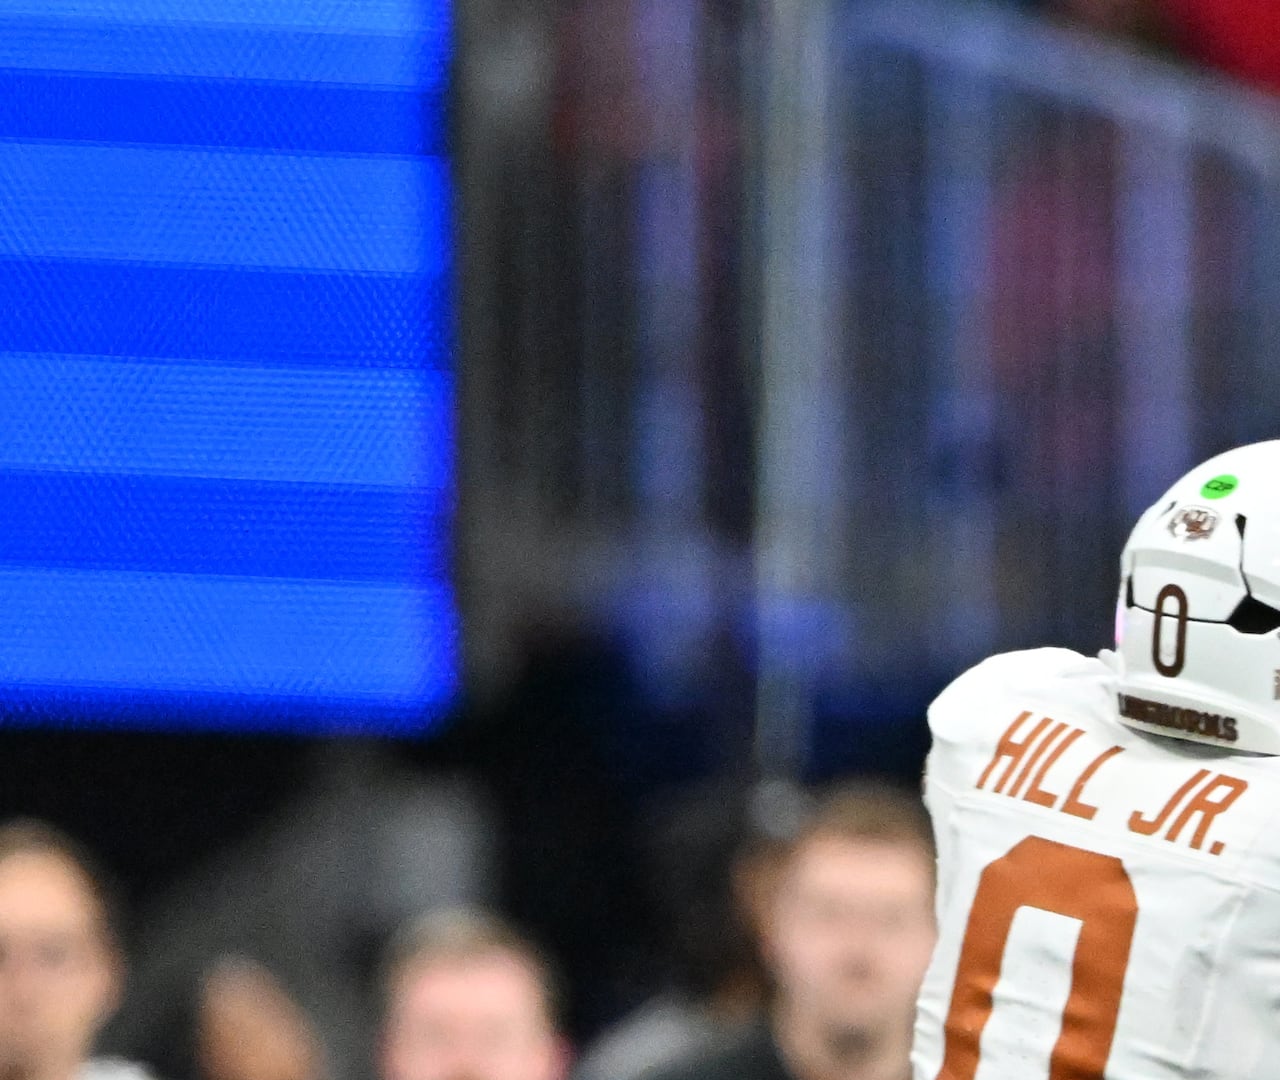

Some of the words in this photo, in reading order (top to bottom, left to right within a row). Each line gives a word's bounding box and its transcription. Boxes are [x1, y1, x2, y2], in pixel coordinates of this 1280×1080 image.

[1152, 583, 1188, 678] 0
[976, 710, 1125, 820] HILL
[1127, 768, 1249, 856] JR.
